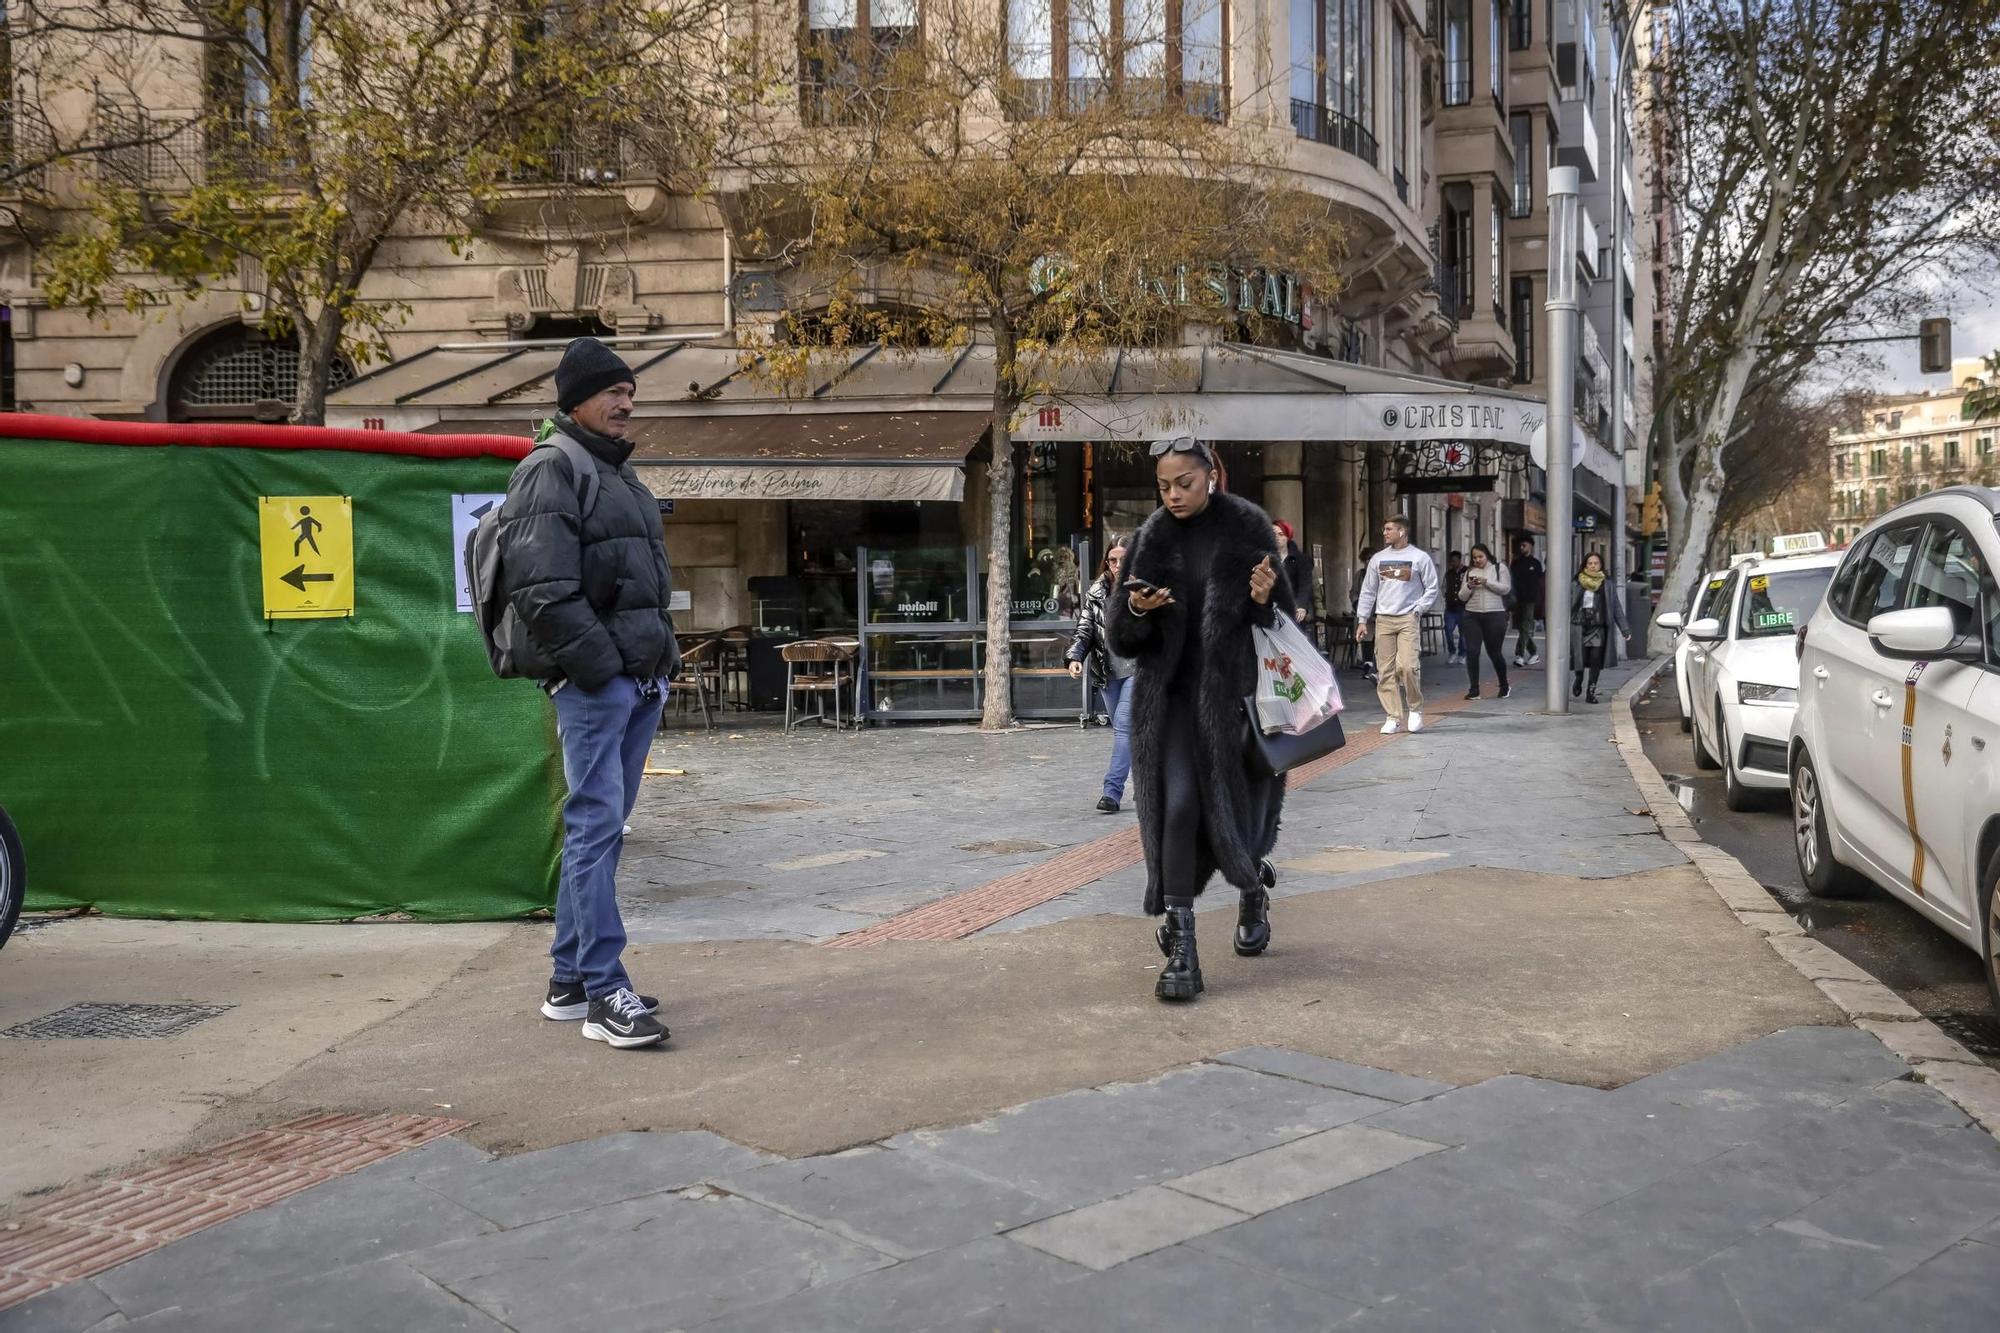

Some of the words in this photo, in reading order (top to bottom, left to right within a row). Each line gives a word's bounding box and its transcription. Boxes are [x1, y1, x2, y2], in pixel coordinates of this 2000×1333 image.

[1404, 405, 1504, 430] CRISTAL
[668, 469, 738, 494] Historia
[739, 474, 757, 491] de
[762, 469, 823, 495] Palma
[1783, 535, 1809, 551] TAXI
[1759, 612, 1793, 626] LIBRE
